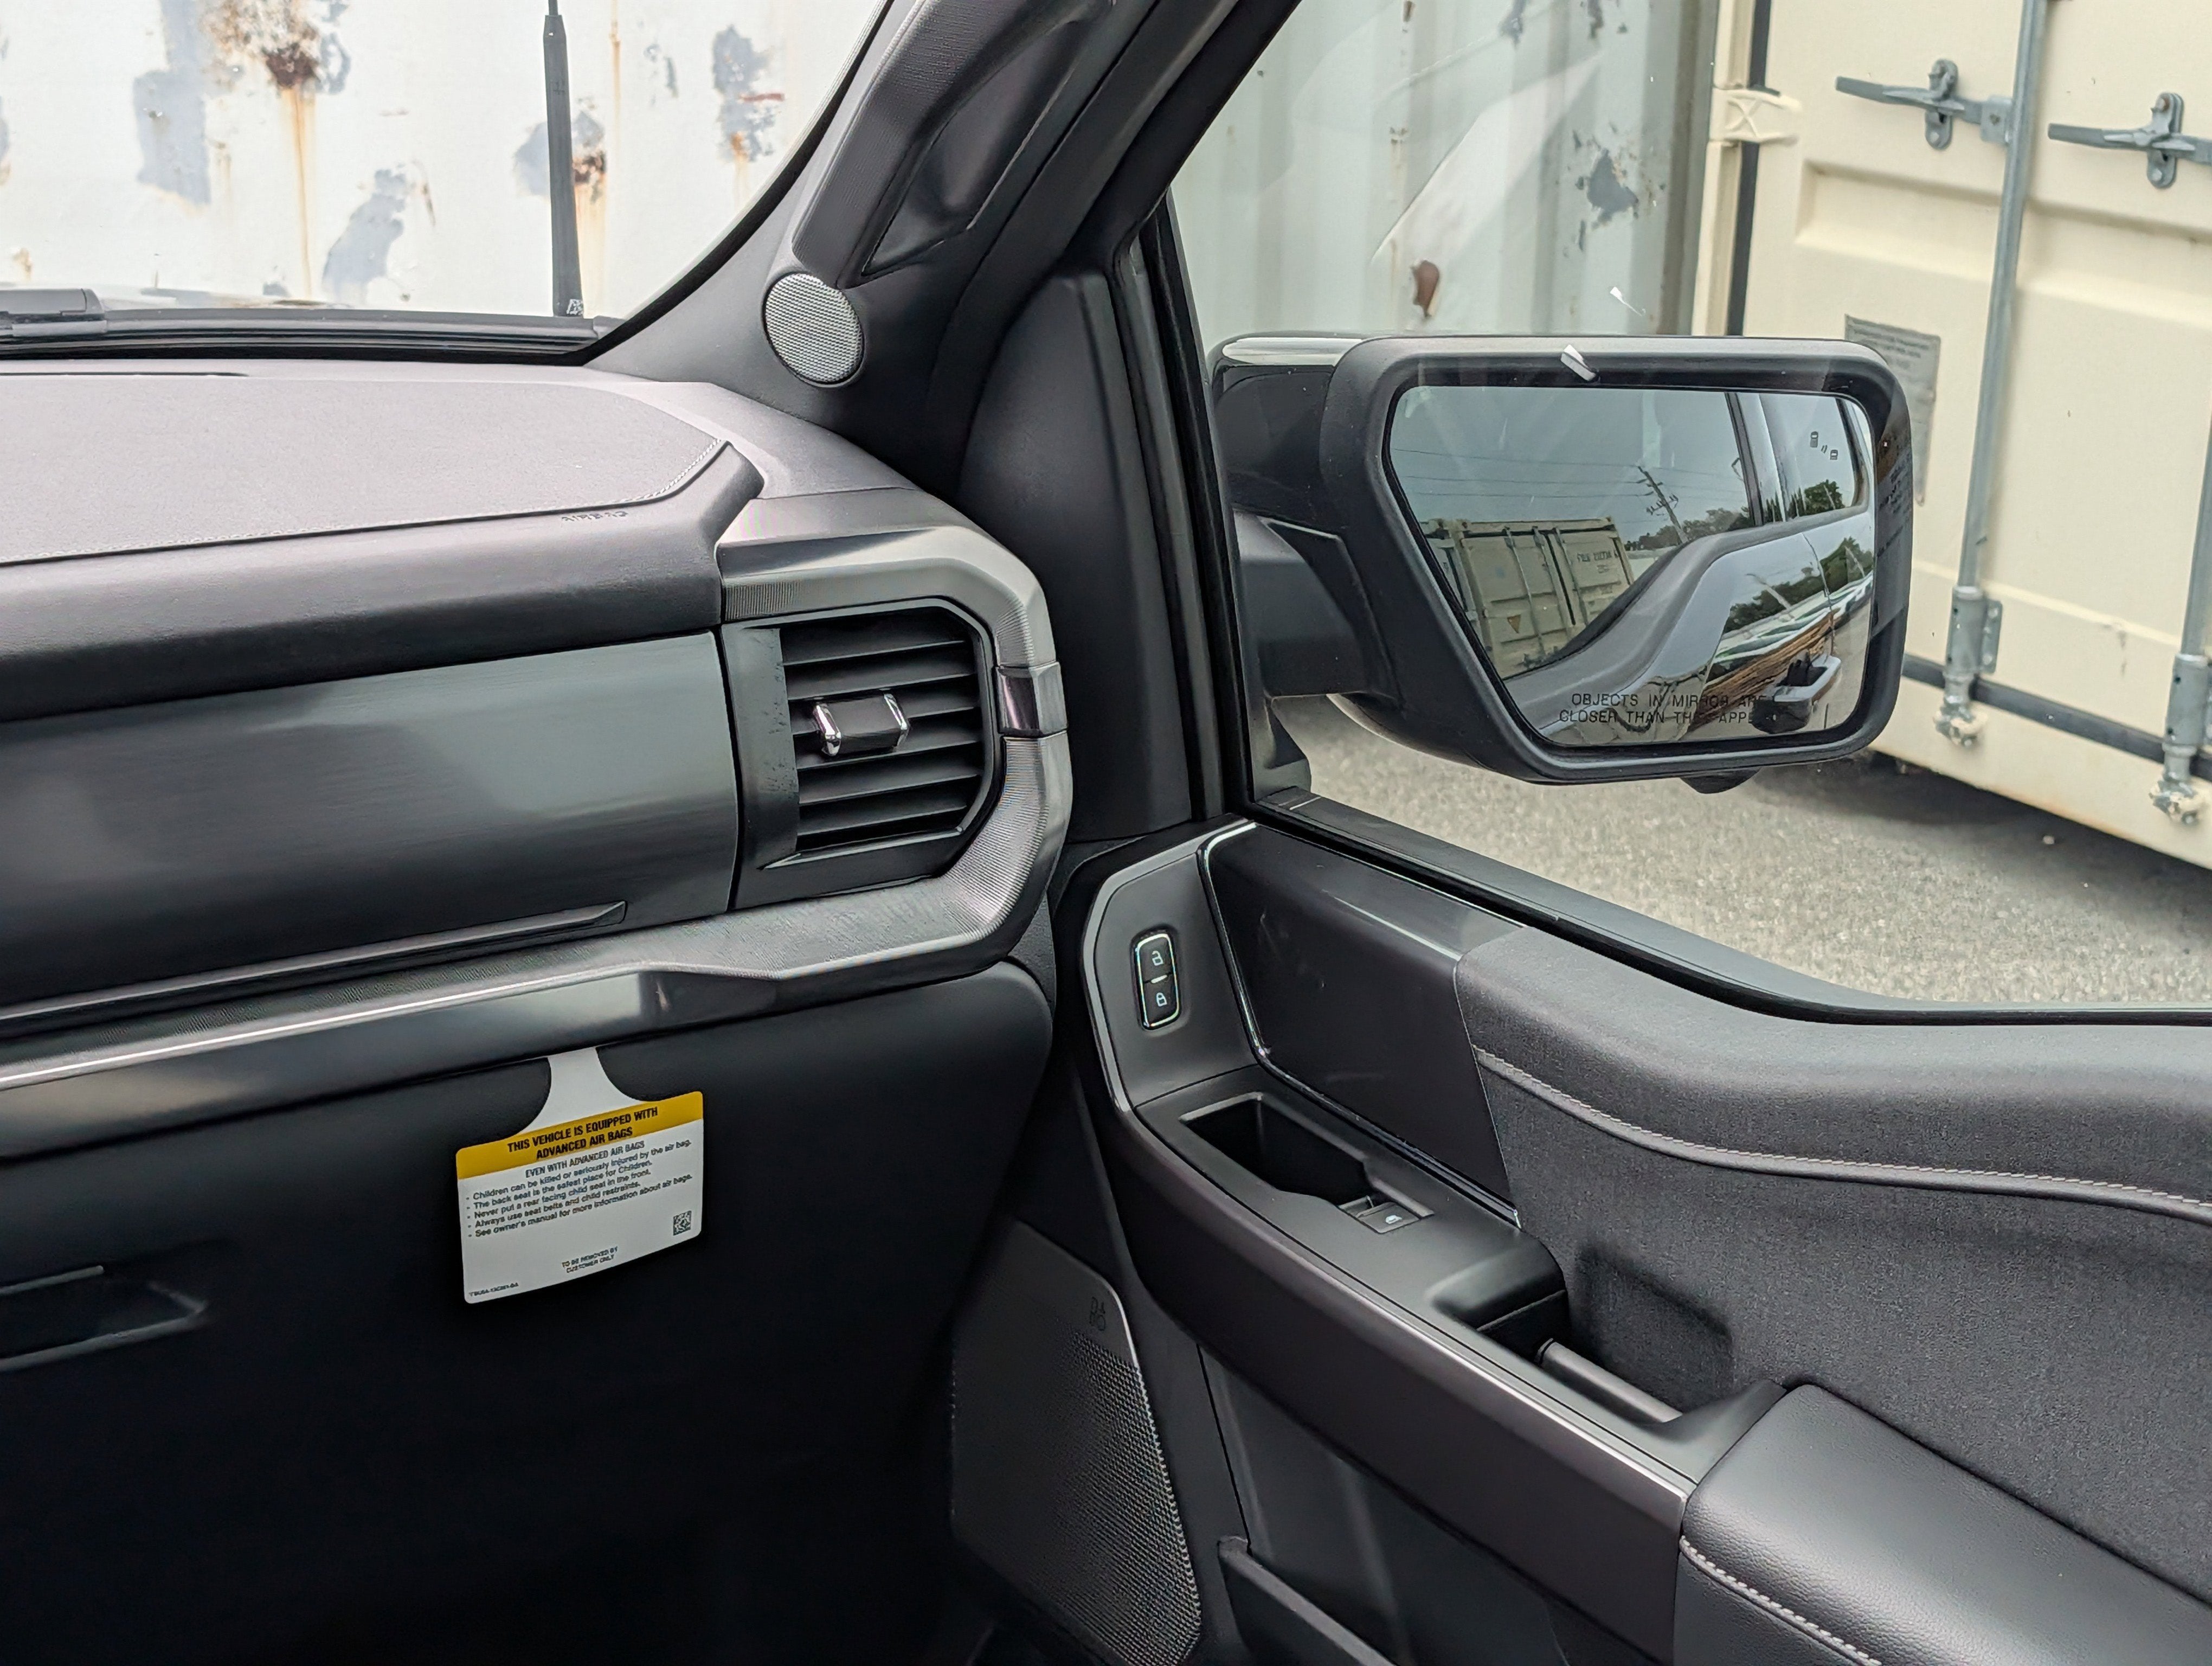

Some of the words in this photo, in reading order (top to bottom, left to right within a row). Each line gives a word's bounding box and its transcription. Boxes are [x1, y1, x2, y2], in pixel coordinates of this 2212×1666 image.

[1559, 709, 1617, 723] CLOSER
[1627, 711, 1664, 723] THAN
[1572, 693, 1638, 707] OBJECTS
[1649, 693, 1662, 707] IN
[1672, 694, 1728, 707] MIRROR
[507, 1139, 530, 1152] THIS
[532, 1128, 571, 1146] VEHICLE
[574, 1125, 583, 1136] IS
[586, 1113, 632, 1133] EQUIPPED
[633, 1106, 658, 1121] WITH
[536, 1138, 587, 1159] ADVANCED
[589, 1134, 605, 1146] AIR
[608, 1126, 633, 1141] BAGS
[473, 1187, 509, 1200] Children
[511, 1183, 525, 1192] can
[540, 1174, 561, 1185] killed
[574, 1162, 609, 1176] seriously
[611, 1153, 638, 1166] injured
[640, 1151, 650, 1159] by
[651, 1148, 663, 1156] the
[665, 1144, 674, 1152] air
[525, 1166, 545, 1178] EVEN
[547, 1160, 567, 1172] WITH
[569, 1150, 608, 1167] ADVANCED
[610, 1146, 623, 1156] AIR
[625, 1140, 645, 1152] BAGS
[474, 1208, 498, 1219] Never
[501, 1204, 515, 1214] put
[523, 1199, 539, 1207] rear
[542, 1192, 567, 1203] facing
[568, 1186, 588, 1196] child
[589, 1181, 606, 1191] seat
[492, 1195, 511, 1206] back
[513, 1191, 531, 1201] seat
[557, 1178, 581, 1190] safest
[583, 1173, 604, 1185] place
[606, 1169, 616, 1177] for
[475, 1216, 505, 1228] Always
[507, 1213, 522, 1221] use
[524, 1207, 541, 1216] seat
[543, 1202, 563, 1212] belts
[565, 1196, 580, 1206] and
[581, 1191, 601, 1202] child
[475, 1229, 491, 1237] See
[493, 1220, 526, 1233] owner's
[528, 1212, 557, 1225] manual
[559, 1209, 570, 1218] for
[572, 1204, 593, 1214] more
[594, 1191, 638, 1208] information
[640, 1183, 661, 1195] about
